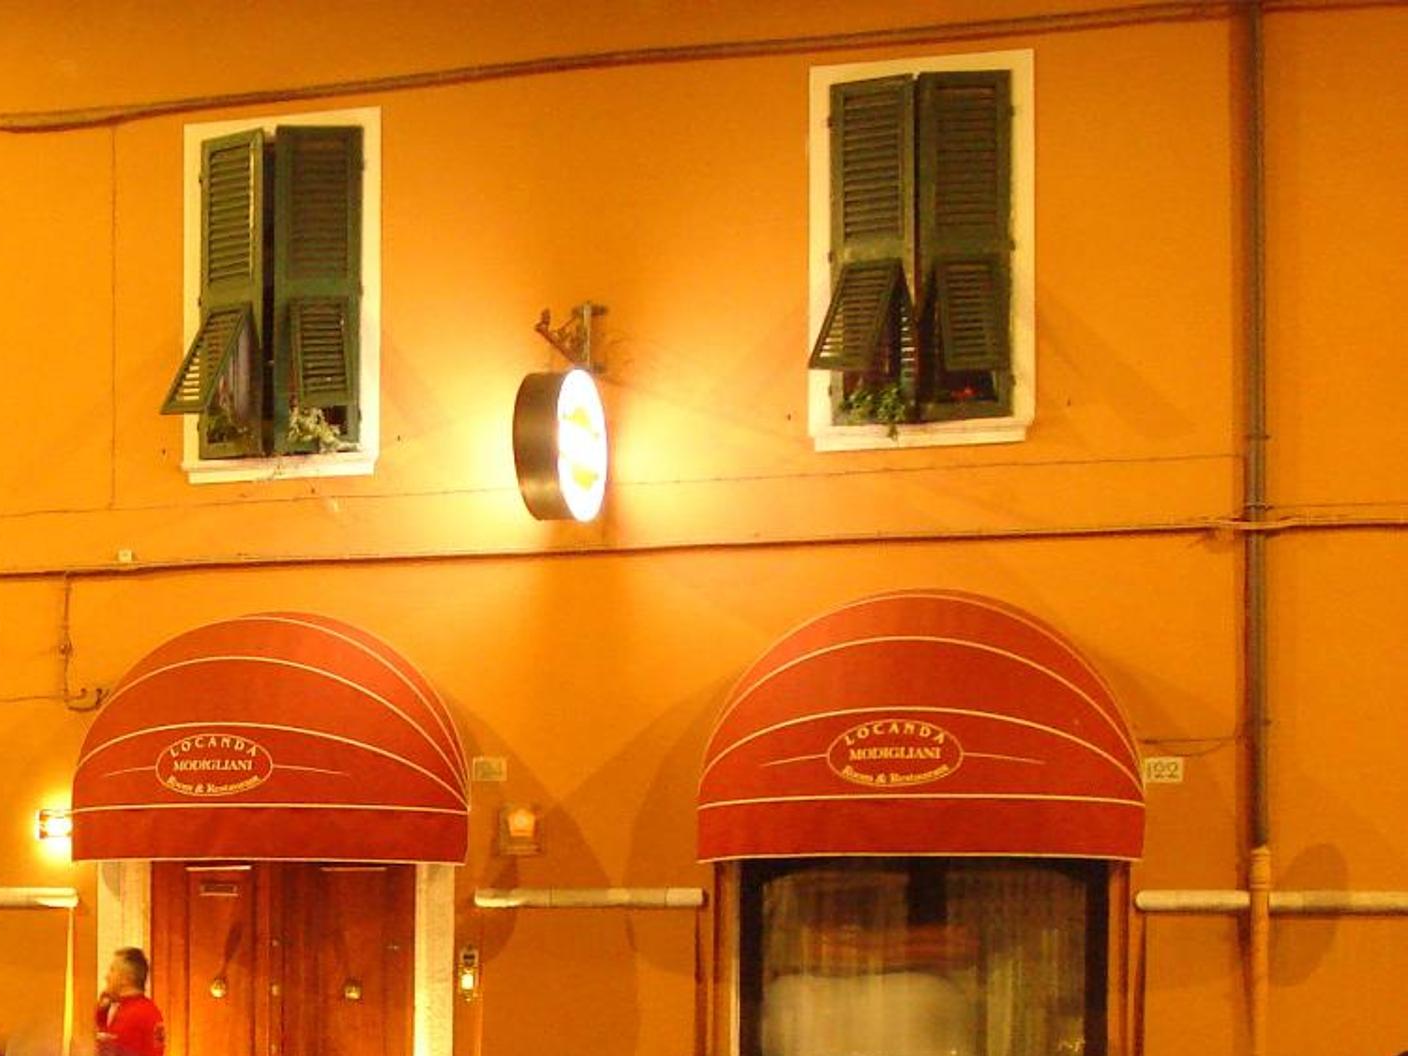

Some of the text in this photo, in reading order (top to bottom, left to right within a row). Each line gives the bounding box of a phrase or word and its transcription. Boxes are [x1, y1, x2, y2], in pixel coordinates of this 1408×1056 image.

[844, 722, 946, 746] LOCANDA
[170, 737, 257, 757] LOCANDA
[848, 746, 942, 761] MODIGLIANI
[173, 759, 253, 771] MODIGLIANI
